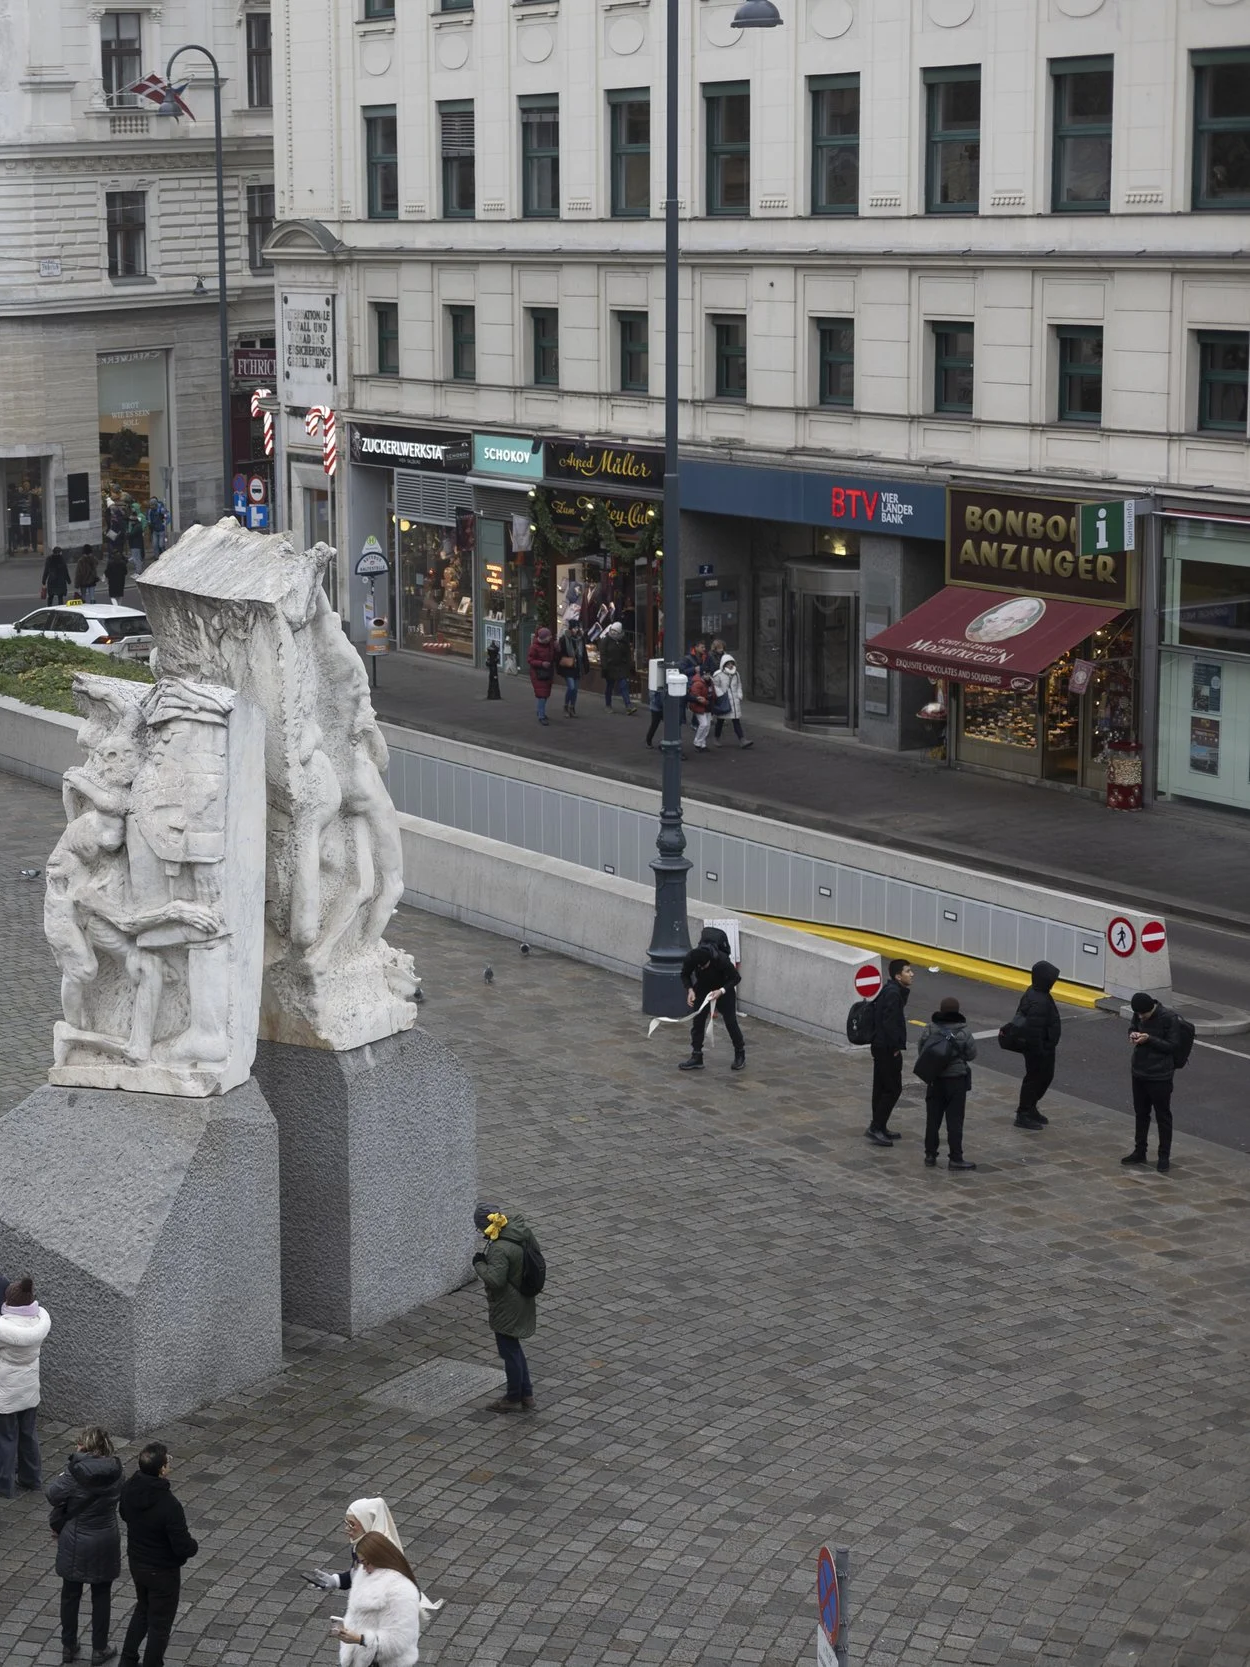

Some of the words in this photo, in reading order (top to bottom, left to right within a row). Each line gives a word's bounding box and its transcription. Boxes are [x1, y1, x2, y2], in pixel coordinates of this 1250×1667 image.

[313, 322, 327, 333] UND
[361, 437, 452, 461] ZUCKERLWERKSTA
[484, 447, 530, 464] SCHOKOV
[581, 449, 652, 478] Müller
[831, 486, 878, 521] BTV
[881, 492, 899, 504] VIER
[881, 502, 914, 516] LÄNDER
[881, 512, 904, 525] BANK
[965, 505, 1077, 543] BONBO
[959, 539, 1118, 584] ANZINGER
[895, 658, 923, 670] EXQUISITE
[922, 664, 958, 678] CHOCOLATES
[958, 669, 971, 680] AND
[971, 672, 1002, 685] SOUVENIRS
